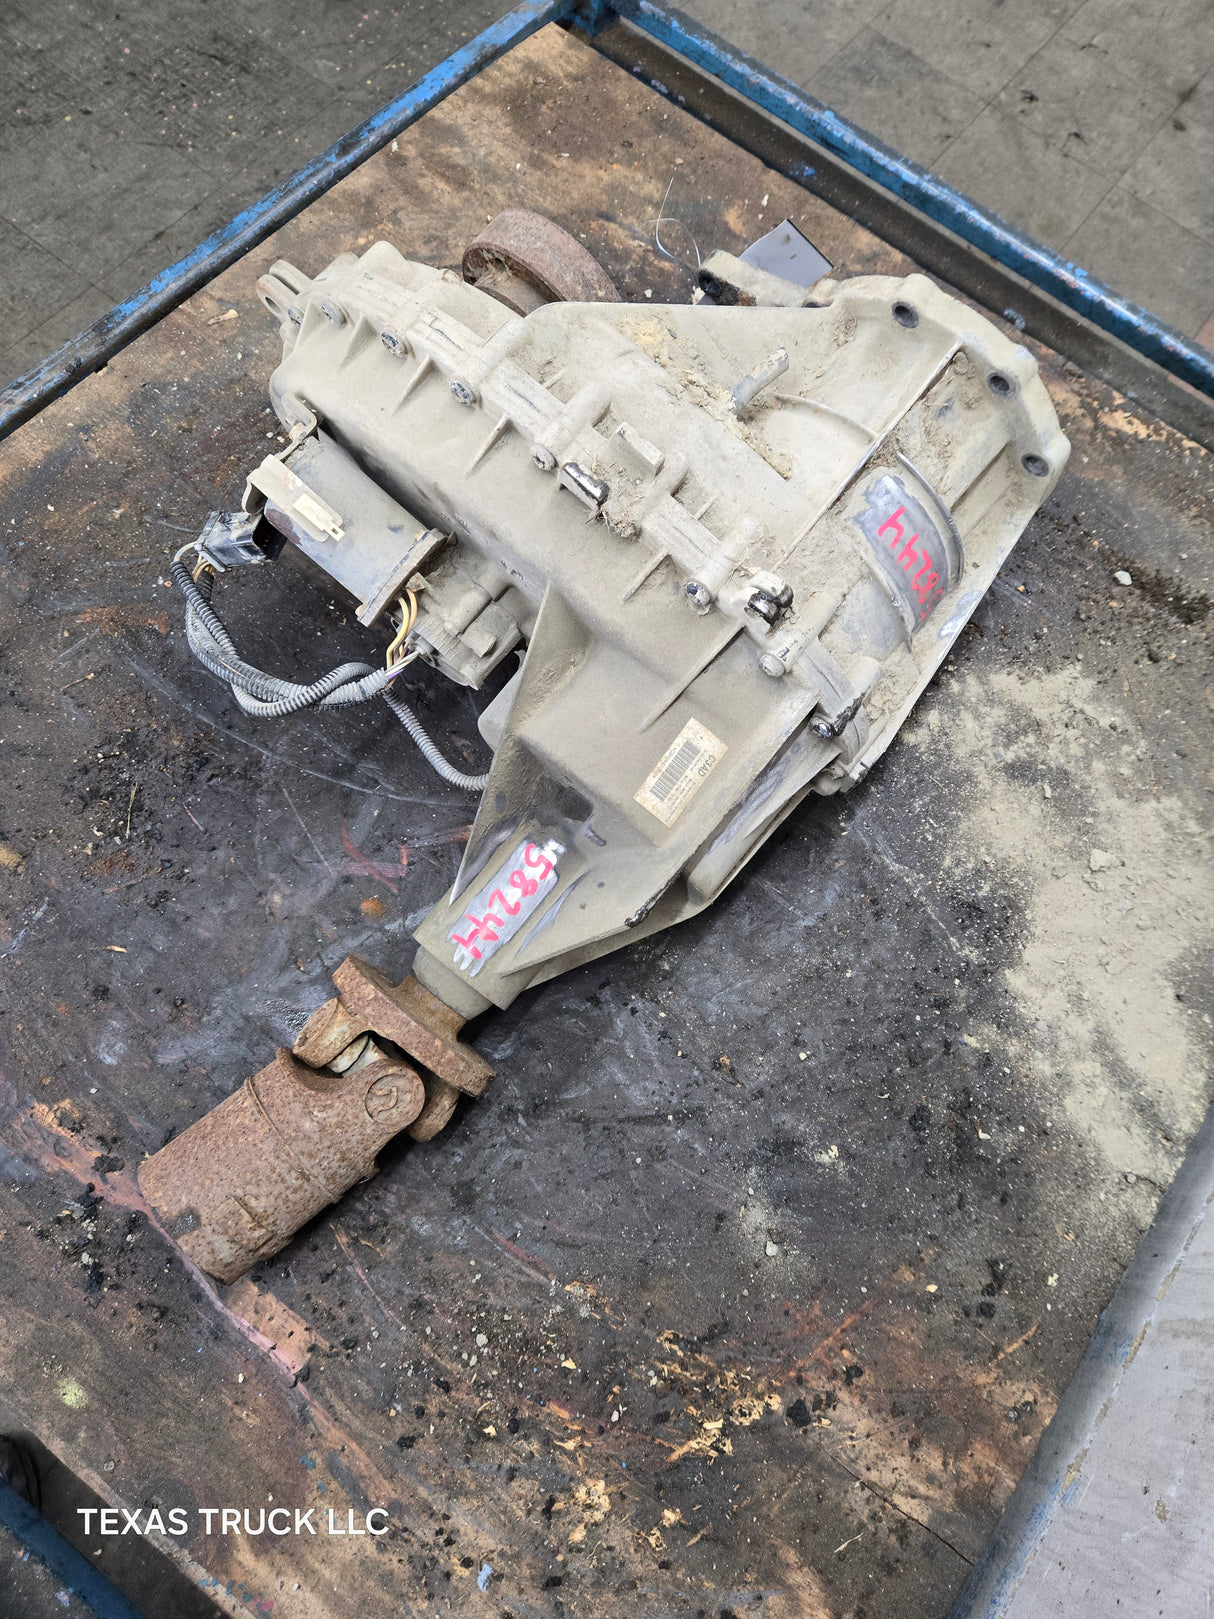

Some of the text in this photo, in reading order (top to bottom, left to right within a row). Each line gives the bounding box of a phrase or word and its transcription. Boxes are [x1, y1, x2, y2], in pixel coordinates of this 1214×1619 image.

[877, 506, 944, 621] 58244
[698, 754, 716, 777] C3AD
[451, 843, 553, 960] 58244
